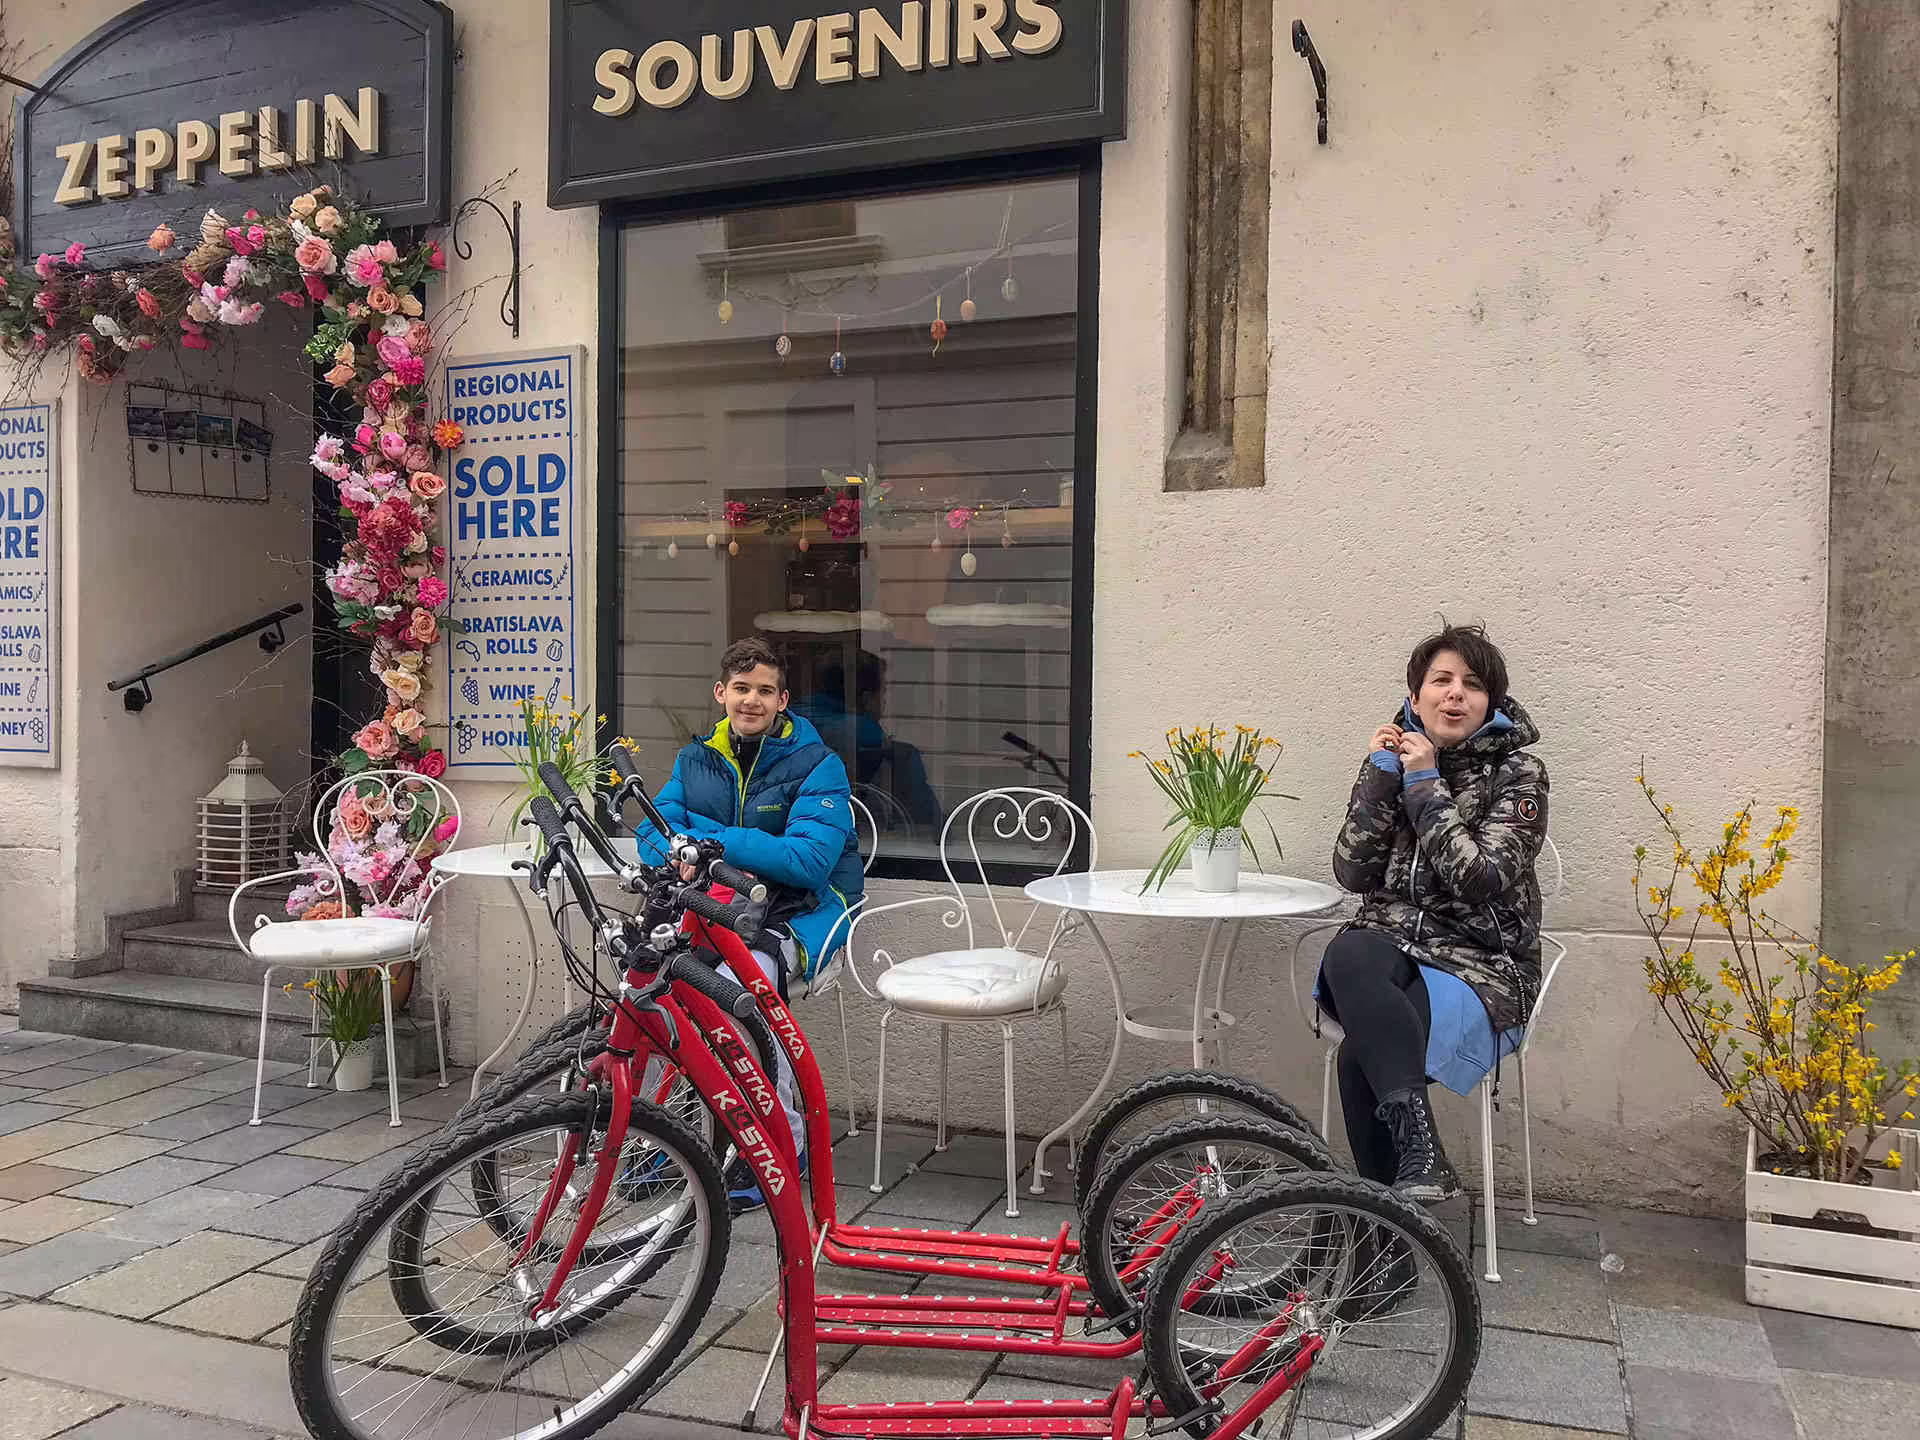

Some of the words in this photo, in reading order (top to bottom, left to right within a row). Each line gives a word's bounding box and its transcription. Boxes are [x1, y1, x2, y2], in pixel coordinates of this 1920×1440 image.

[592, 0, 1063, 117] SOUVENIRS
[53, 87, 380, 205] ZEPPELIN
[454, 369, 565, 398] REGIONAL
[454, 398, 567, 426] PRODUCTS
[454, 453, 567, 498] SOLD
[0, 487, 45, 520] LD
[458, 498, 560, 540] HERE
[0, 526, 39, 559] RE
[471, 569, 554, 587] CERAMICS
[463, 616, 564, 633] BRATISLAVA
[0, 643, 23, 656] LLS
[486, 638, 538, 655] ROLLS
[489, 684, 535, 700] WINE
[0, 721, 27, 735] NEY
[482, 730, 539, 747] HONE
